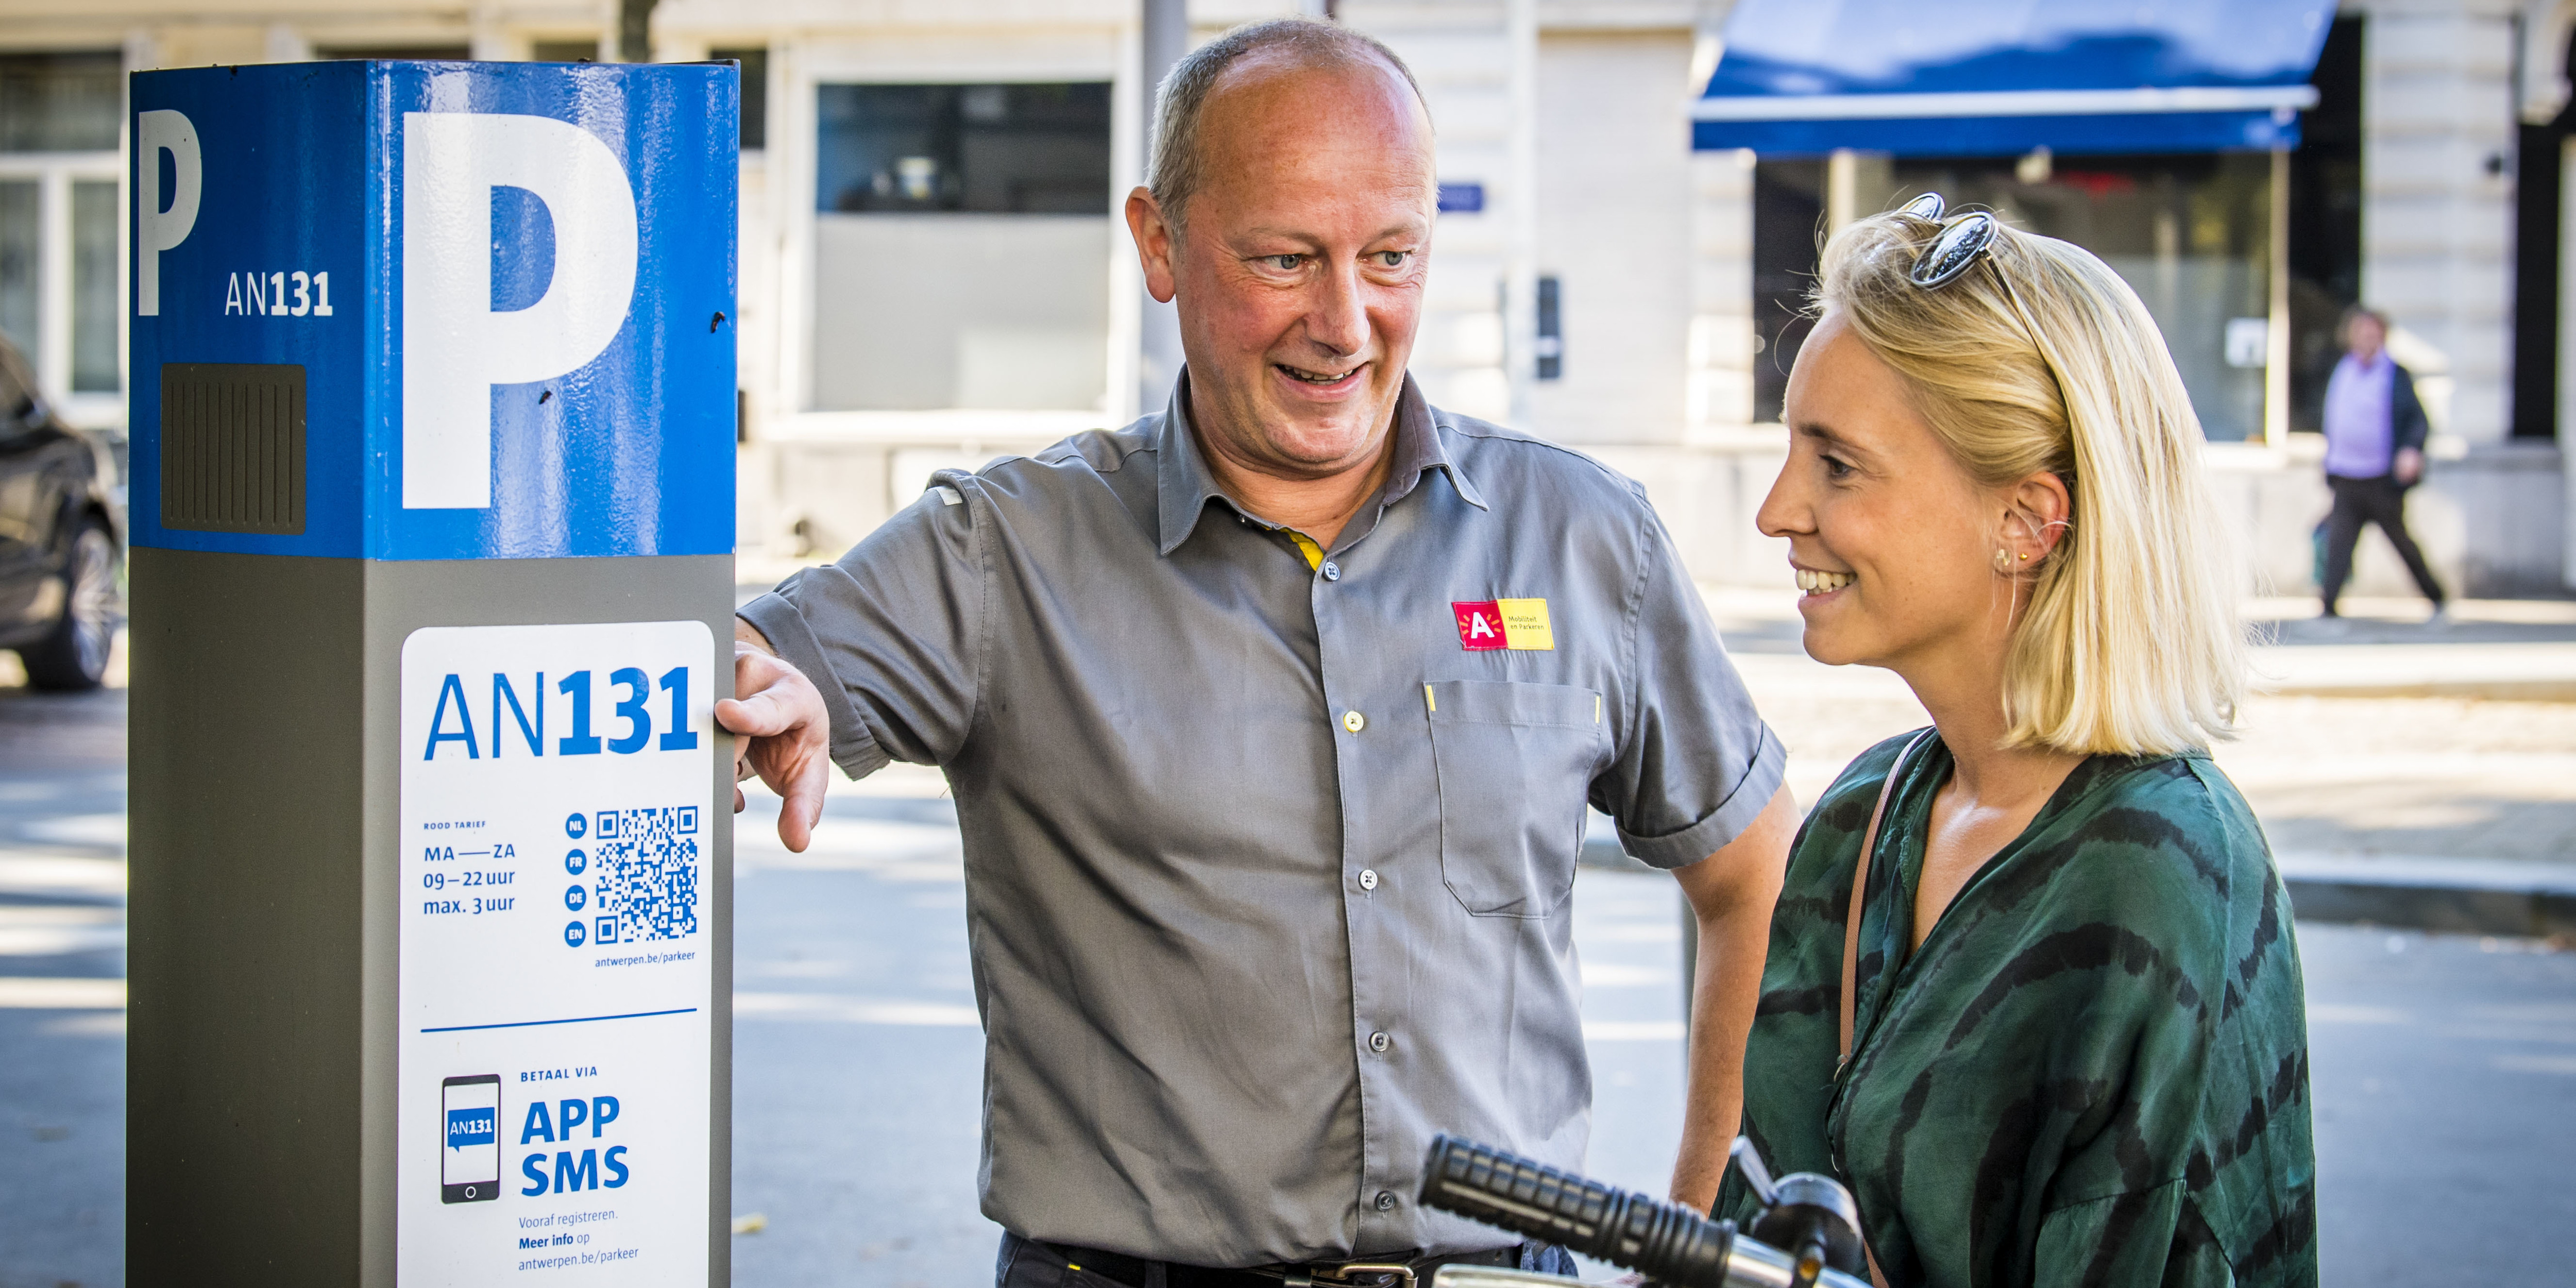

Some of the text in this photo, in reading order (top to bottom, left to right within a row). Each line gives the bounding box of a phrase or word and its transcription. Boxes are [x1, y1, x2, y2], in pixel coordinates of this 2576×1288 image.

[138, 109, 202, 316] P
[225, 270, 333, 317] AN131
[403, 112, 638, 509] P
[1471, 612, 1495, 639] A
[423, 666, 698, 761] AN131
[569, 820, 583, 832] NL
[425, 846, 454, 861] MA
[494, 844, 515, 858] ZA
[569, 856, 583, 868] FR
[486, 872, 515, 885] uur
[424, 898, 515, 914] max. 3 uur
[569, 892, 583, 904] DE
[568, 929, 583, 940] EN
[595, 951, 696, 967] antwerpen.be/parkeer
[521, 1066, 597, 1082] BETAAL VIA
[450, 1119, 493, 1135] AN131
[520, 1096, 620, 1145] APP
[521, 1145, 629, 1197] SMS
[519, 1211, 618, 1229] Vooraf registreren.
[519, 1233, 590, 1250] Meer info op
[518, 1247, 638, 1271] antwerpen.be/parkeer
